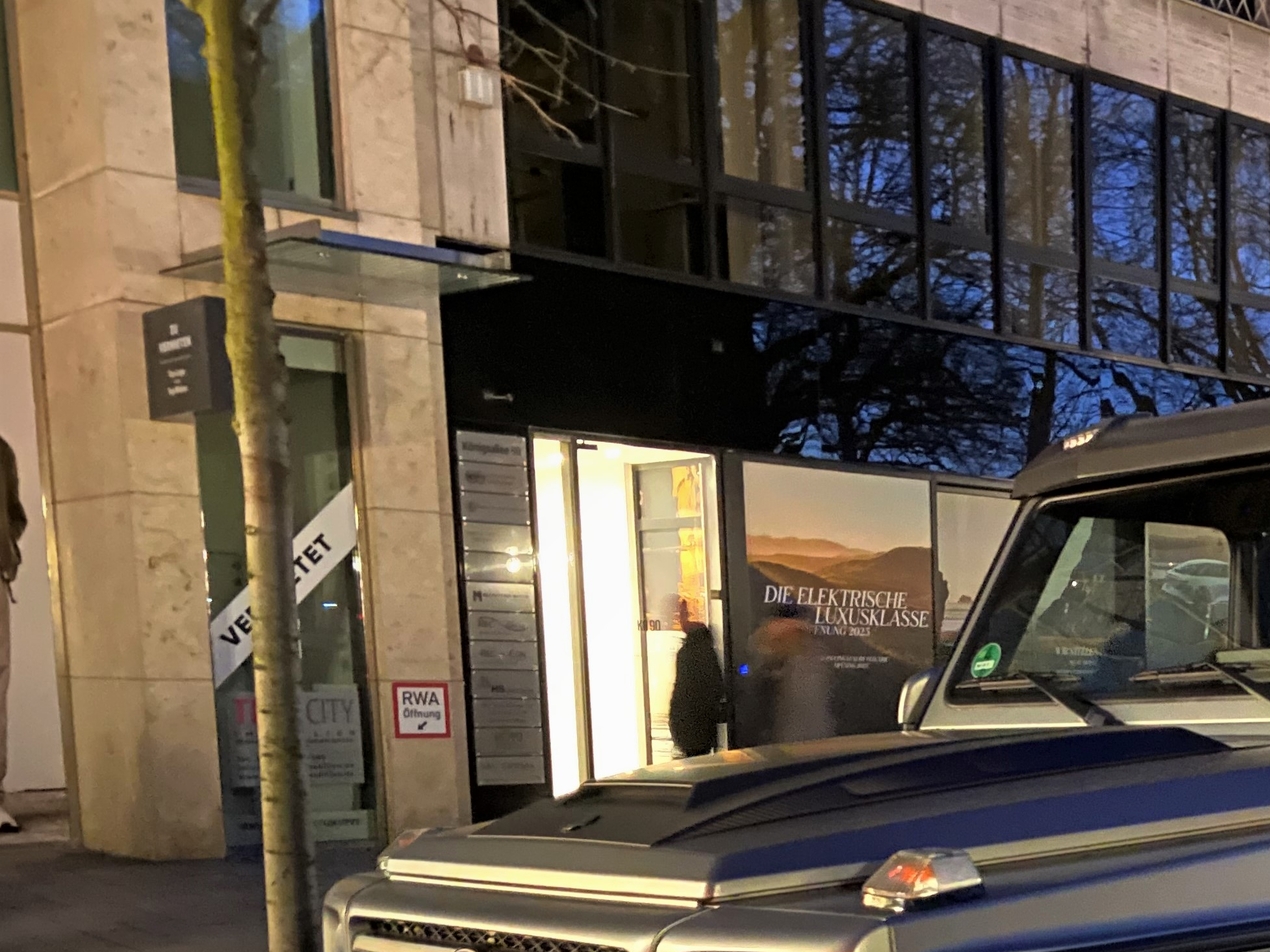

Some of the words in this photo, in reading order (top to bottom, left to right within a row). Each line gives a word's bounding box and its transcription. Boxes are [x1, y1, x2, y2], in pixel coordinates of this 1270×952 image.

[764, 585, 794, 605] DIE
[797, 587, 908, 610] ELEKTRISCHE
[815, 606, 930, 629] LUXUSKLASSE
[848, 627, 871, 638] 2025
[402, 691, 441, 706] RWA
[305, 698, 355, 725] CITY
[403, 708, 442, 721] Öffnung
